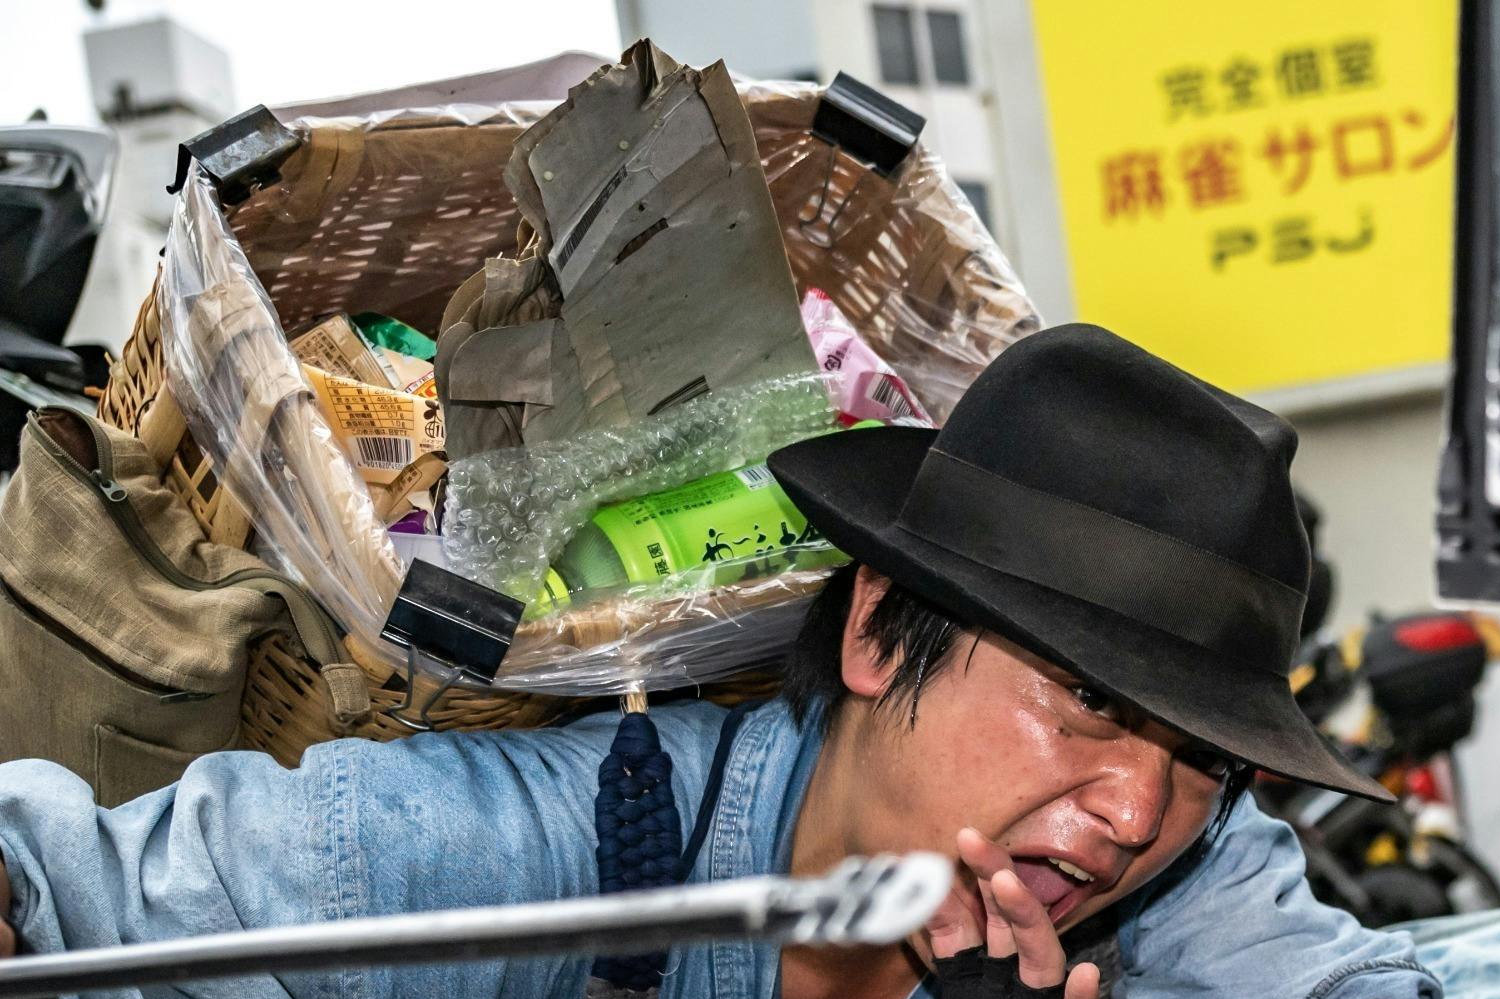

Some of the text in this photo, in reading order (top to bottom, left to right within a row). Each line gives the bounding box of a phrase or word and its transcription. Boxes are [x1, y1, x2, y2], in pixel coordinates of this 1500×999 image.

[1160, 37, 1379, 122] 完全個室
[1099, 105, 1456, 224] 麻雀サロン
